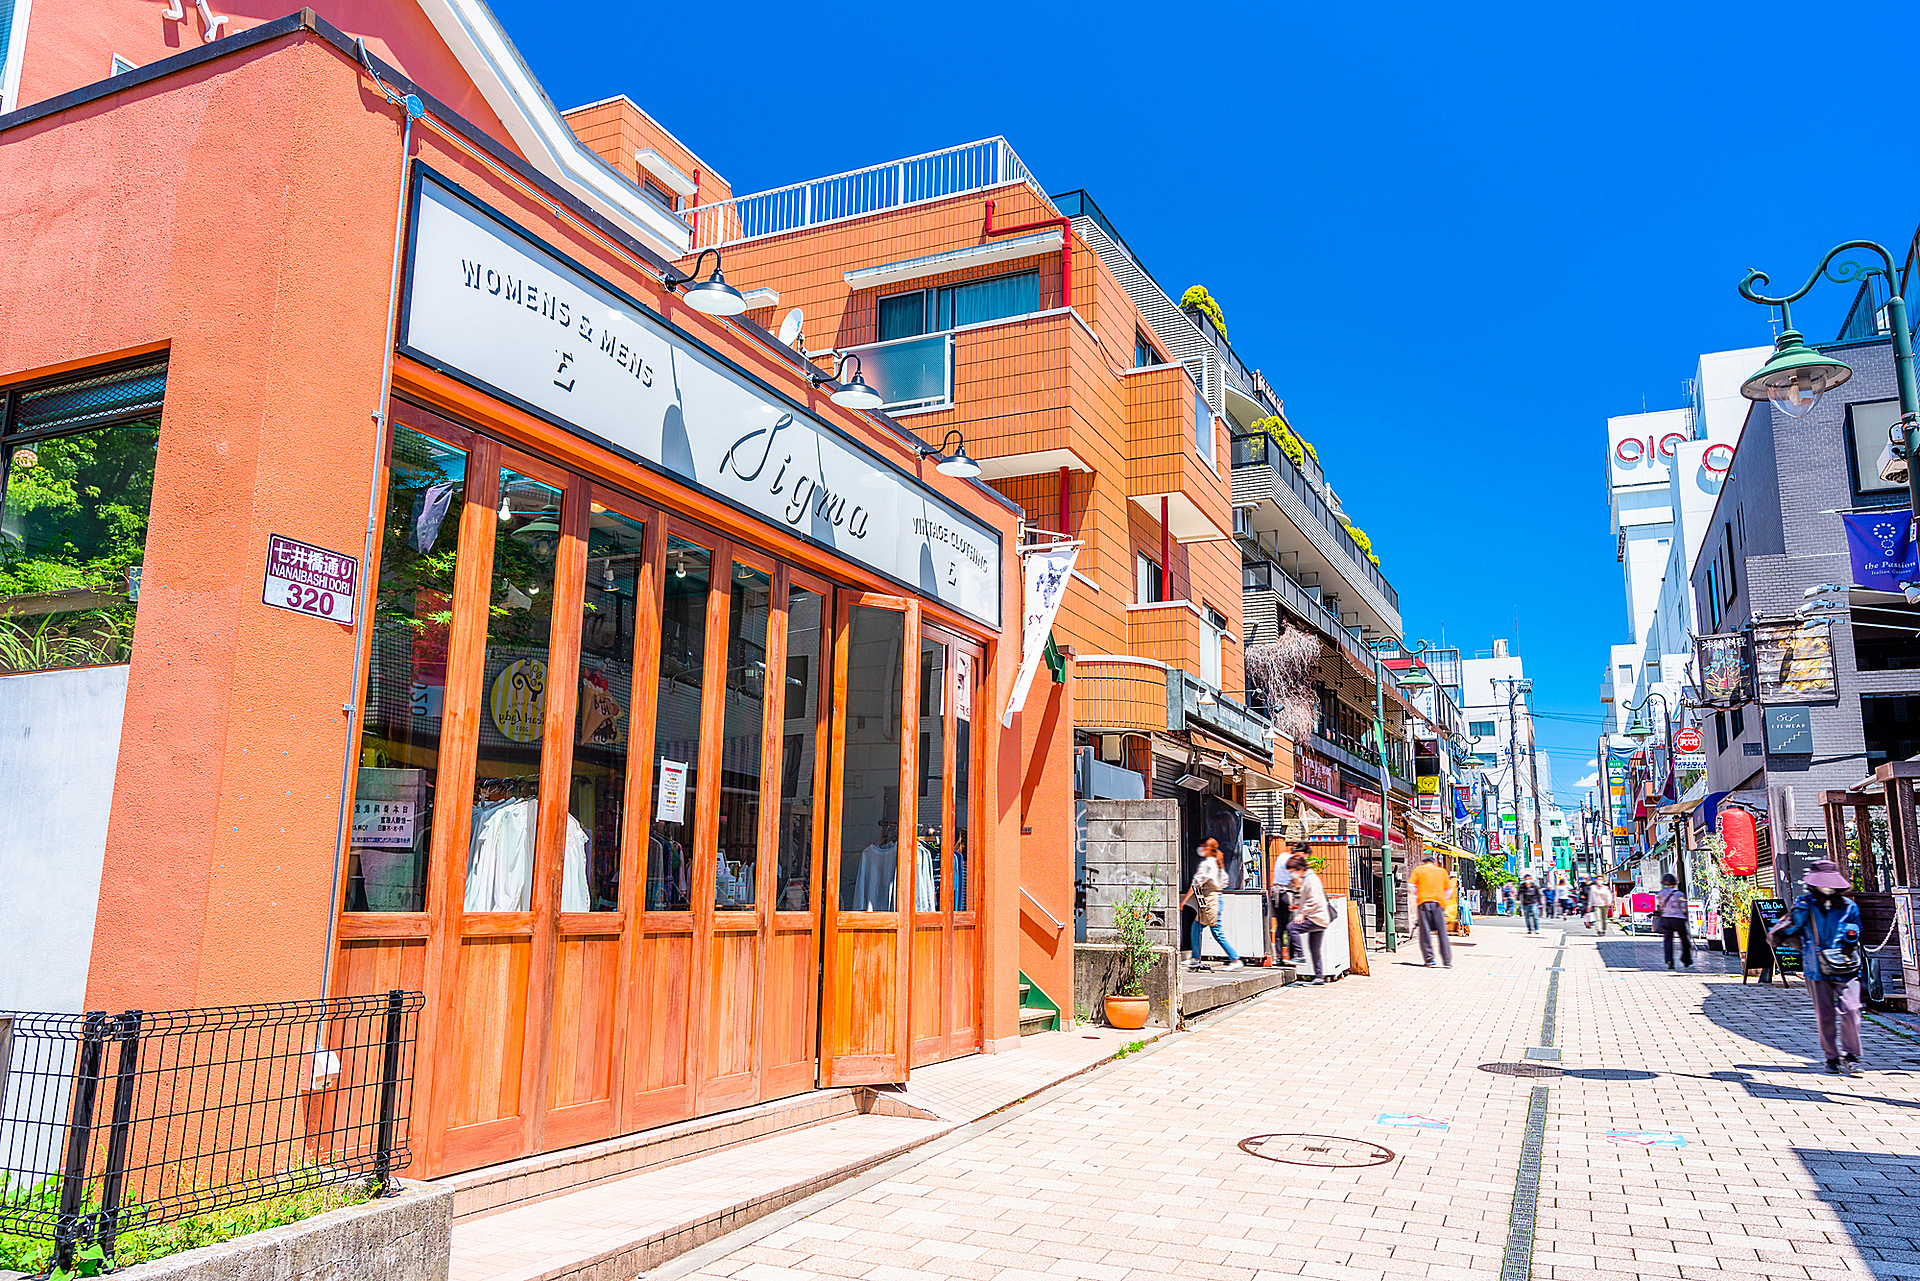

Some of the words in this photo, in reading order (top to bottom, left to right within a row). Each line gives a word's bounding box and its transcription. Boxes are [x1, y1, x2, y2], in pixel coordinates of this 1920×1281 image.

[461, 259, 571, 327] WOMENS
[600, 329, 654, 388] MENS
[719, 412, 868, 539] Sigma
[273, 541, 352, 580] 七井橋通り
[912, 517, 948, 543] VINTAGE
[951, 532, 988, 573] CLOTHING
[271, 562, 328, 589] NANAIBASHI
[328, 579, 351, 595] DORI
[1864, 562, 1879, 570] the
[1881, 561, 1916, 569] Passion
[286, 583, 334, 616] 320
[1701, 637, 1748, 651] 沖縄料理
